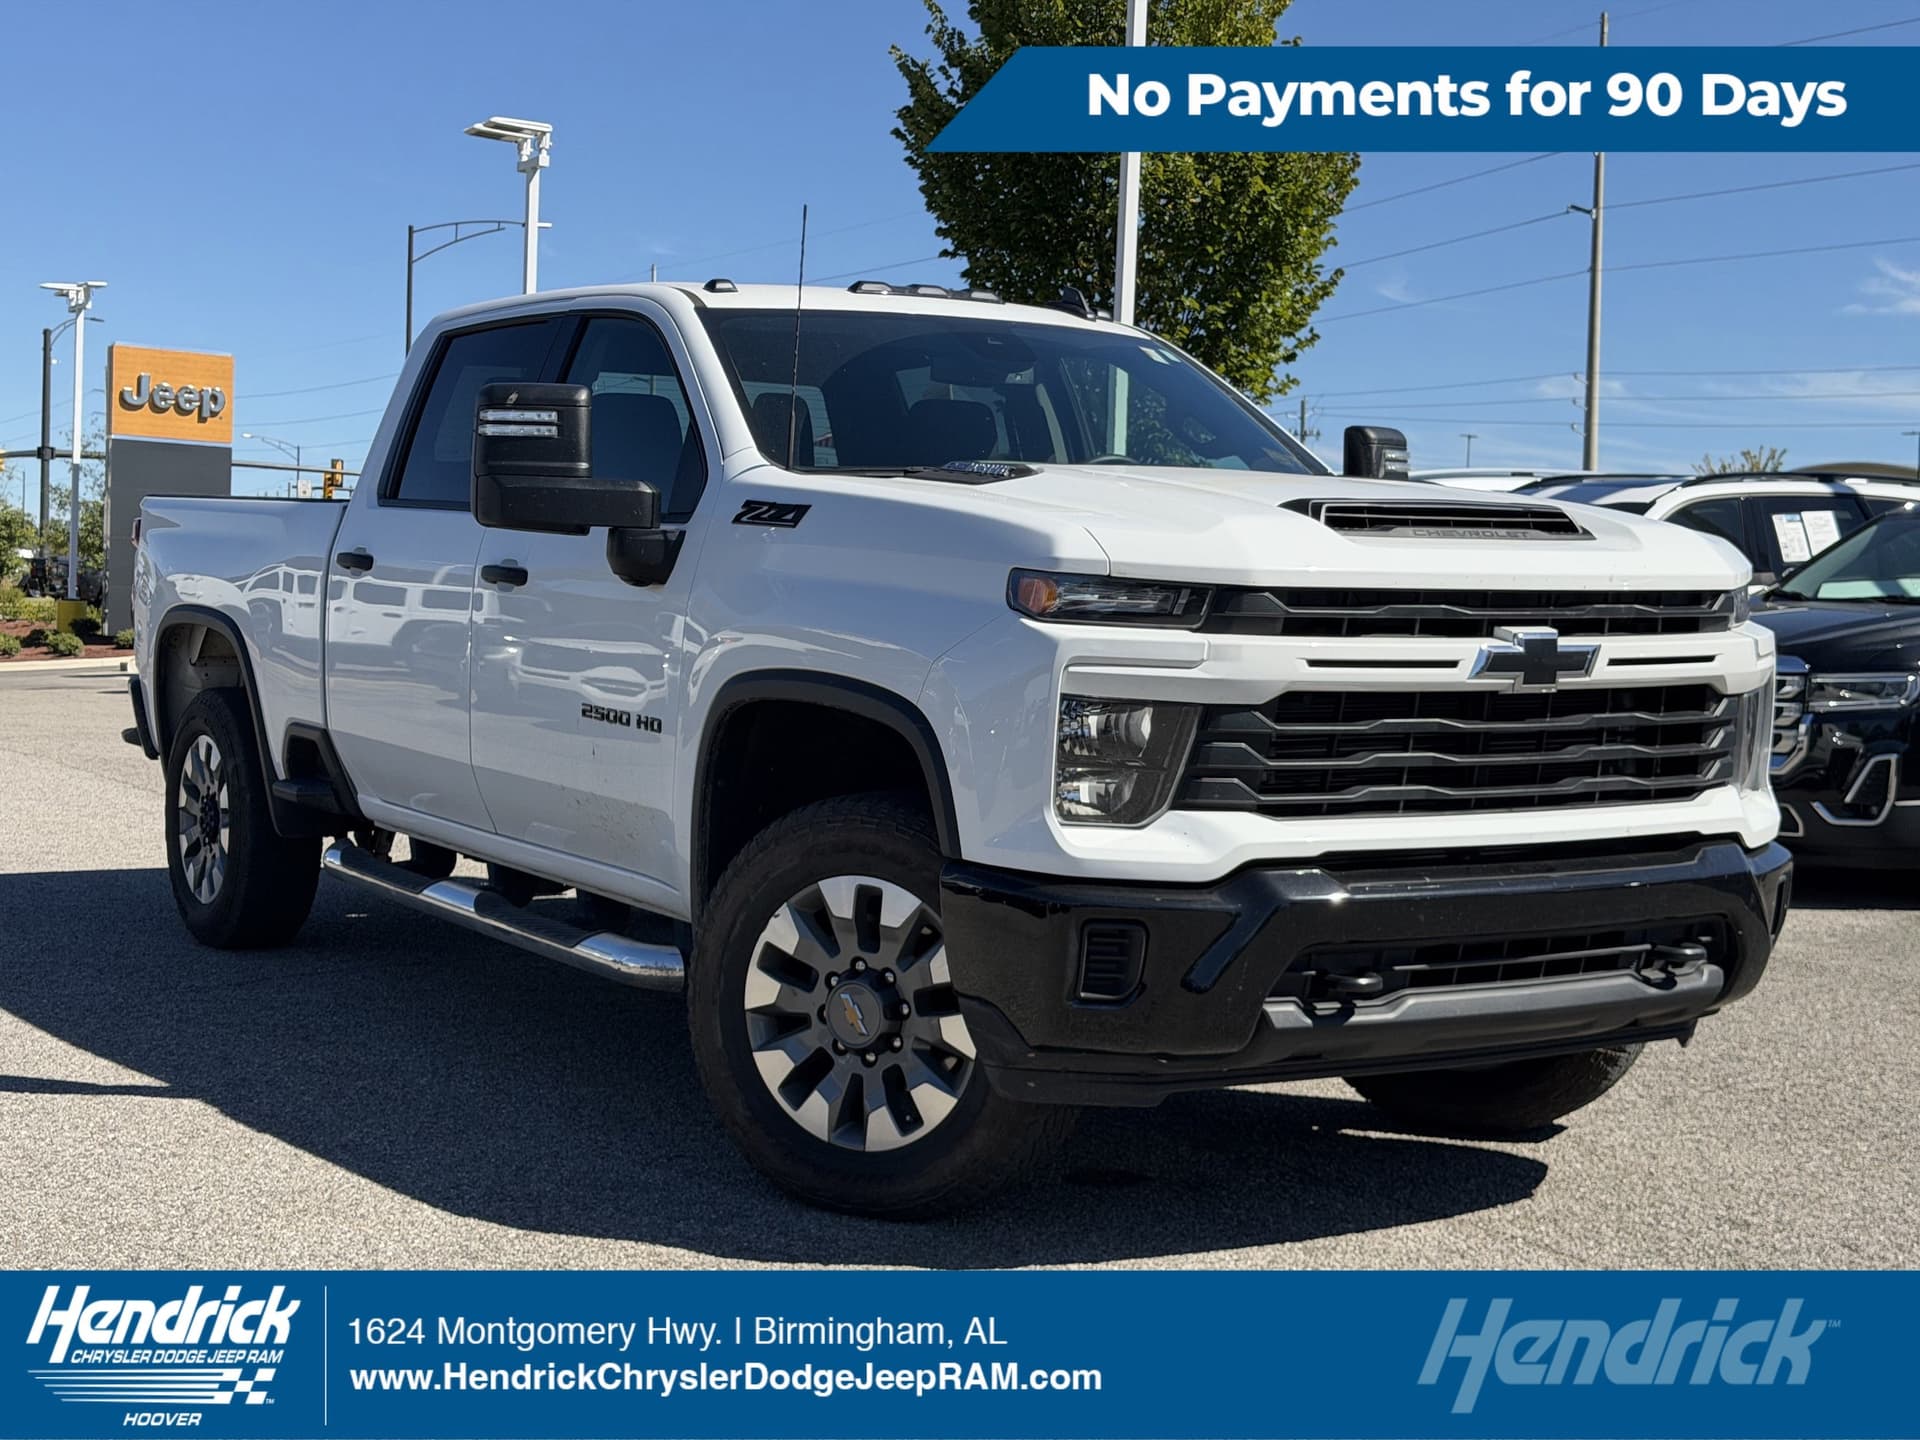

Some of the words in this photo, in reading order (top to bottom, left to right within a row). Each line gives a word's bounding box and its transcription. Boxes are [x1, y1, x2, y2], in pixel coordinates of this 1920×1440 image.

[119, 372, 226, 423] Jeep
[1412, 528, 1529, 538] CHEVROLET
[581, 702, 631, 728] 2500
[636, 714, 662, 734] HD
